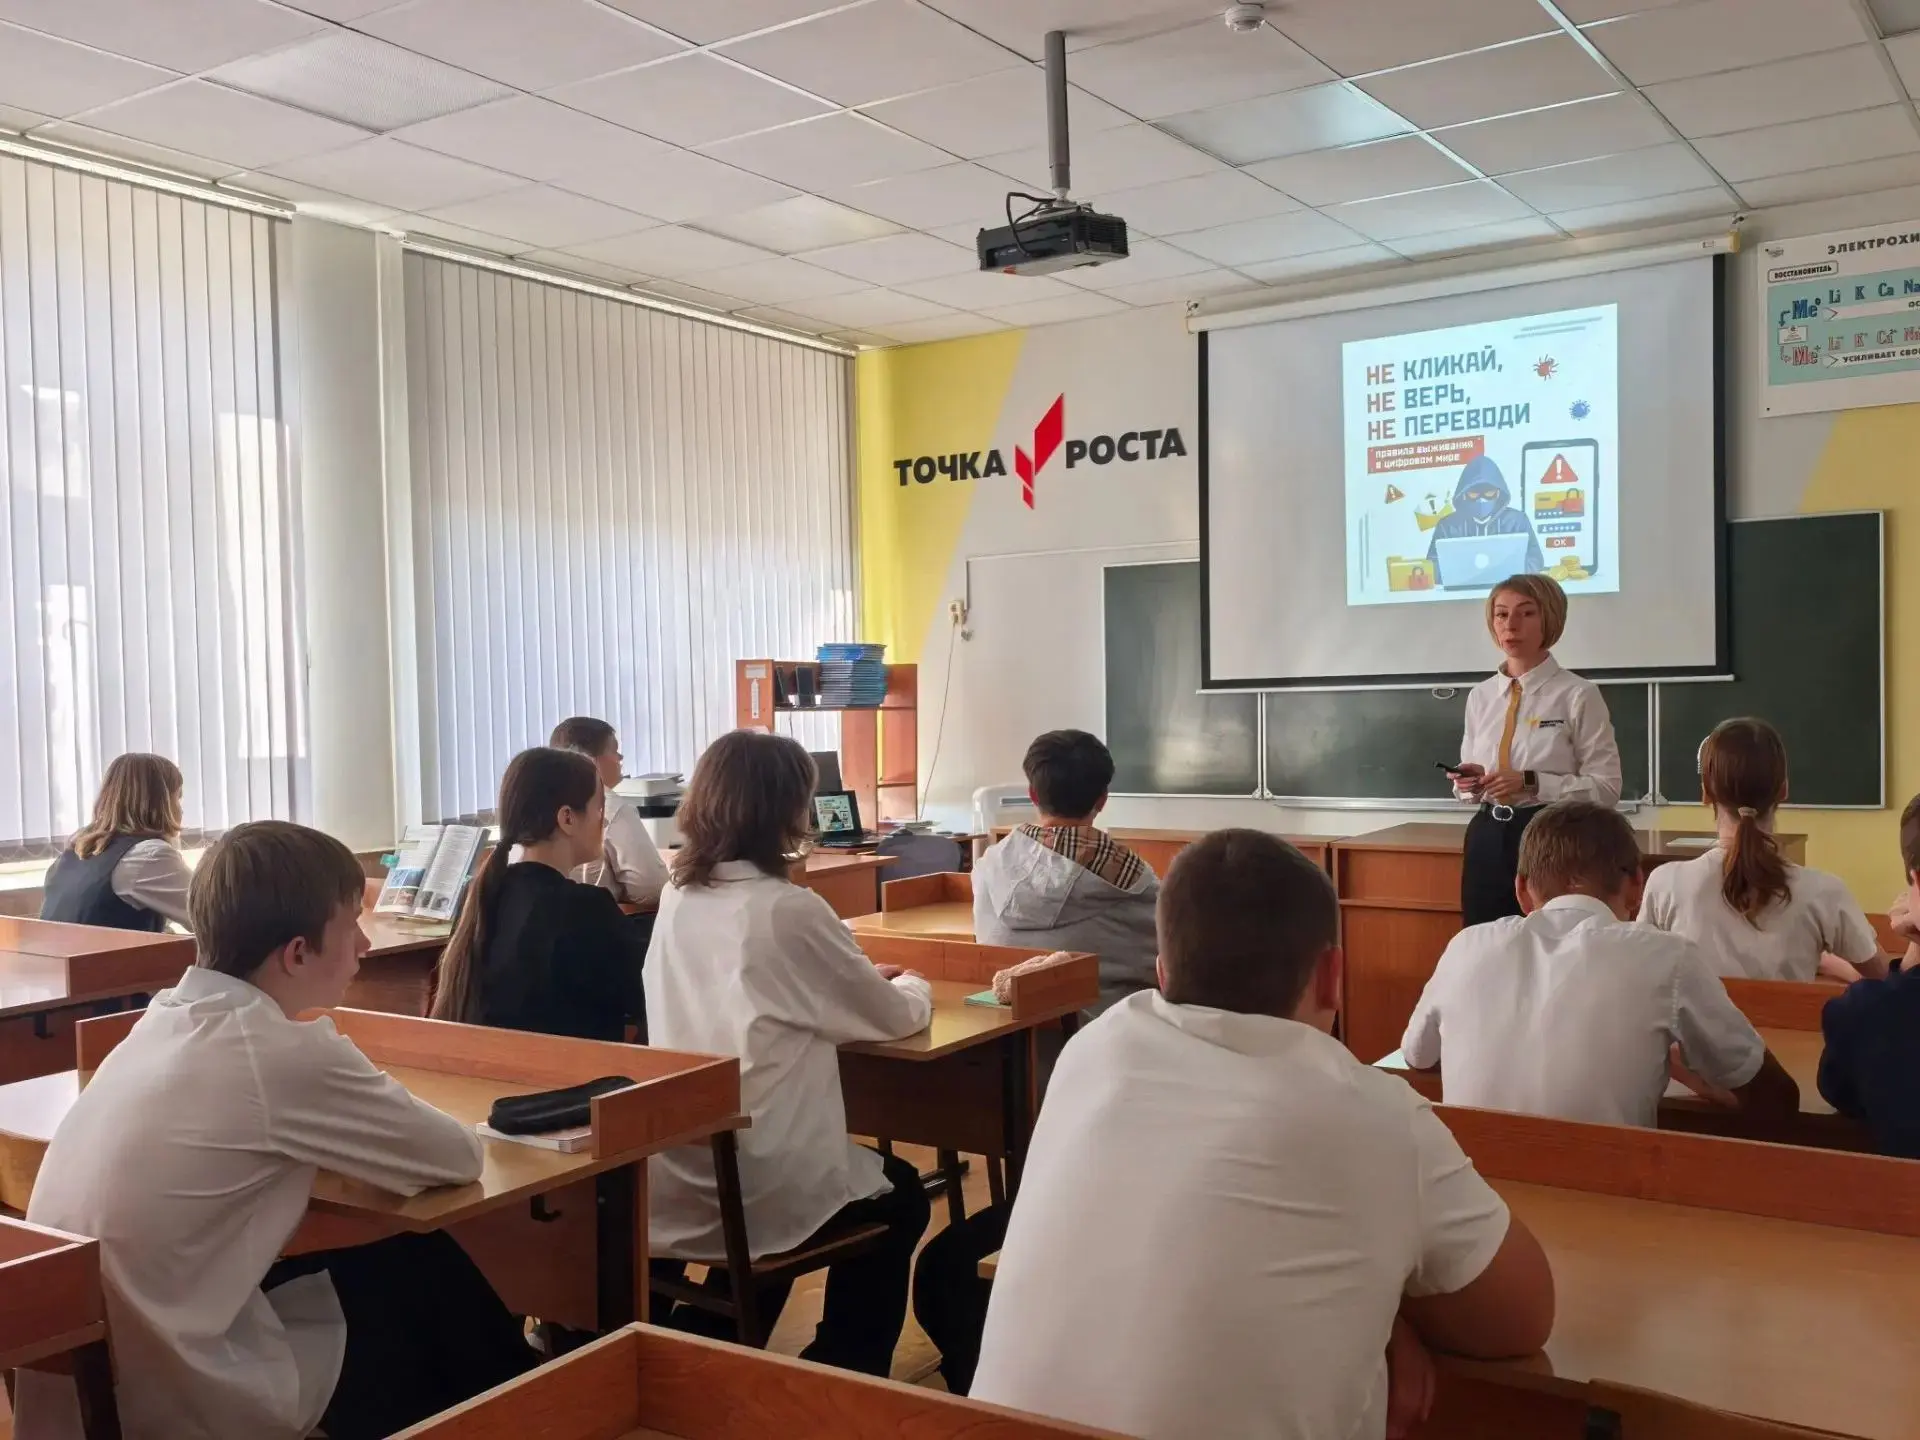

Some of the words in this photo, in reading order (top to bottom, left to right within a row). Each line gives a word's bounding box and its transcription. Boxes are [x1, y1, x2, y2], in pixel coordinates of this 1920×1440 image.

[1774, 265, 1832, 279] ВОССТАНОВИТЕЛЬ
[1854, 286, 1865, 300] K
[1878, 282, 1895, 297] Ca
[1842, 351, 1896, 363] УСИЛИВАЕТ
[1900, 347, 1920, 357] СВО
[1366, 363, 1396, 386] НЕ
[1403, 345, 1503, 381] КЛИКАЙ,
[1367, 391, 1396, 414] НЕ
[1404, 383, 1471, 409] ВЕРЬ,
[1367, 418, 1396, 441] НЕ
[1404, 402, 1531, 437] ПЕРЕВОДИ
[893, 449, 1007, 487] ТОЧКА
[1065, 428, 1187, 469] РОСТА
[1375, 448, 1415, 459] правила
[1416, 440, 1475, 454] выживания
[1383, 455, 1434, 470] цифровом
[1435, 453, 1461, 464] мире
